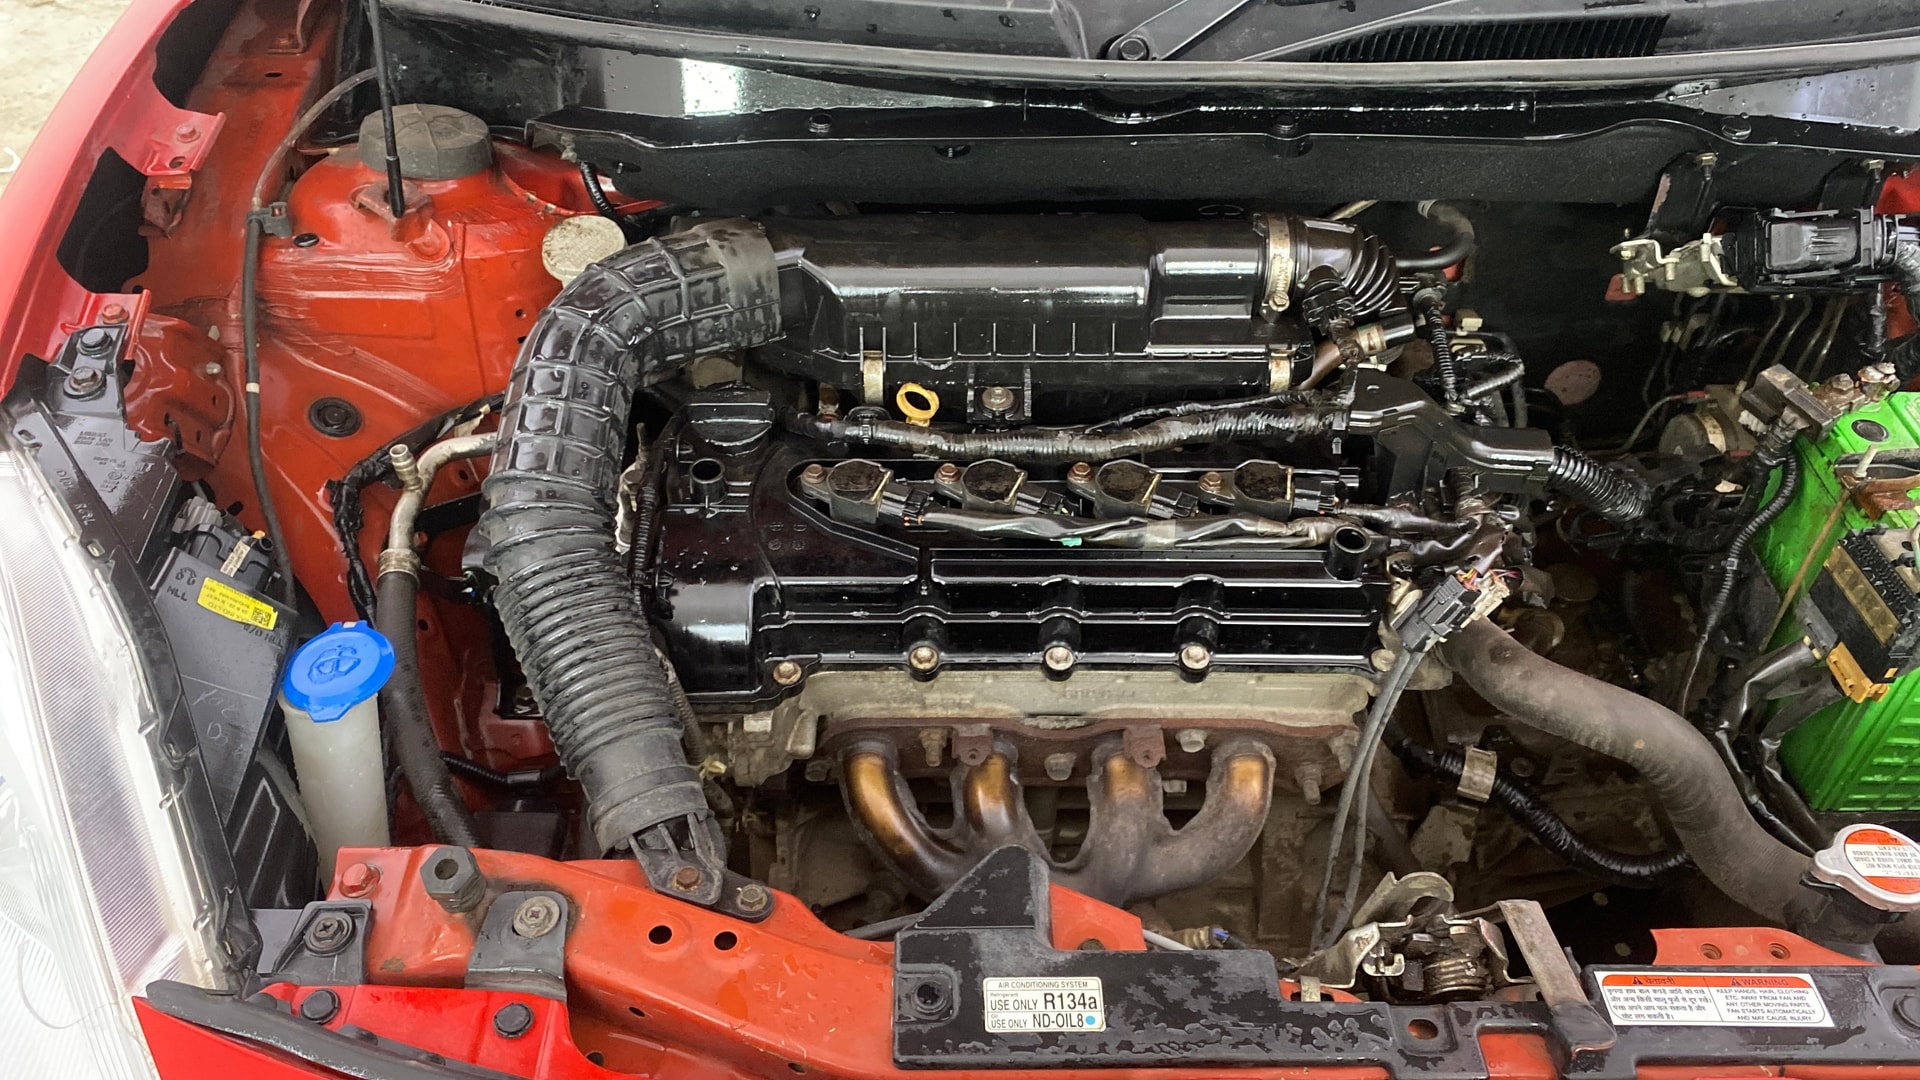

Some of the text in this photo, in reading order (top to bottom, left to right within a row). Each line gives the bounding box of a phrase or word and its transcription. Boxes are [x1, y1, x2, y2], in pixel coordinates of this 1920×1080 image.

[990, 993, 1098, 1010] USE ONLY R134a
[991, 1013, 1084, 1028] USE ONLY ND-OIL8
